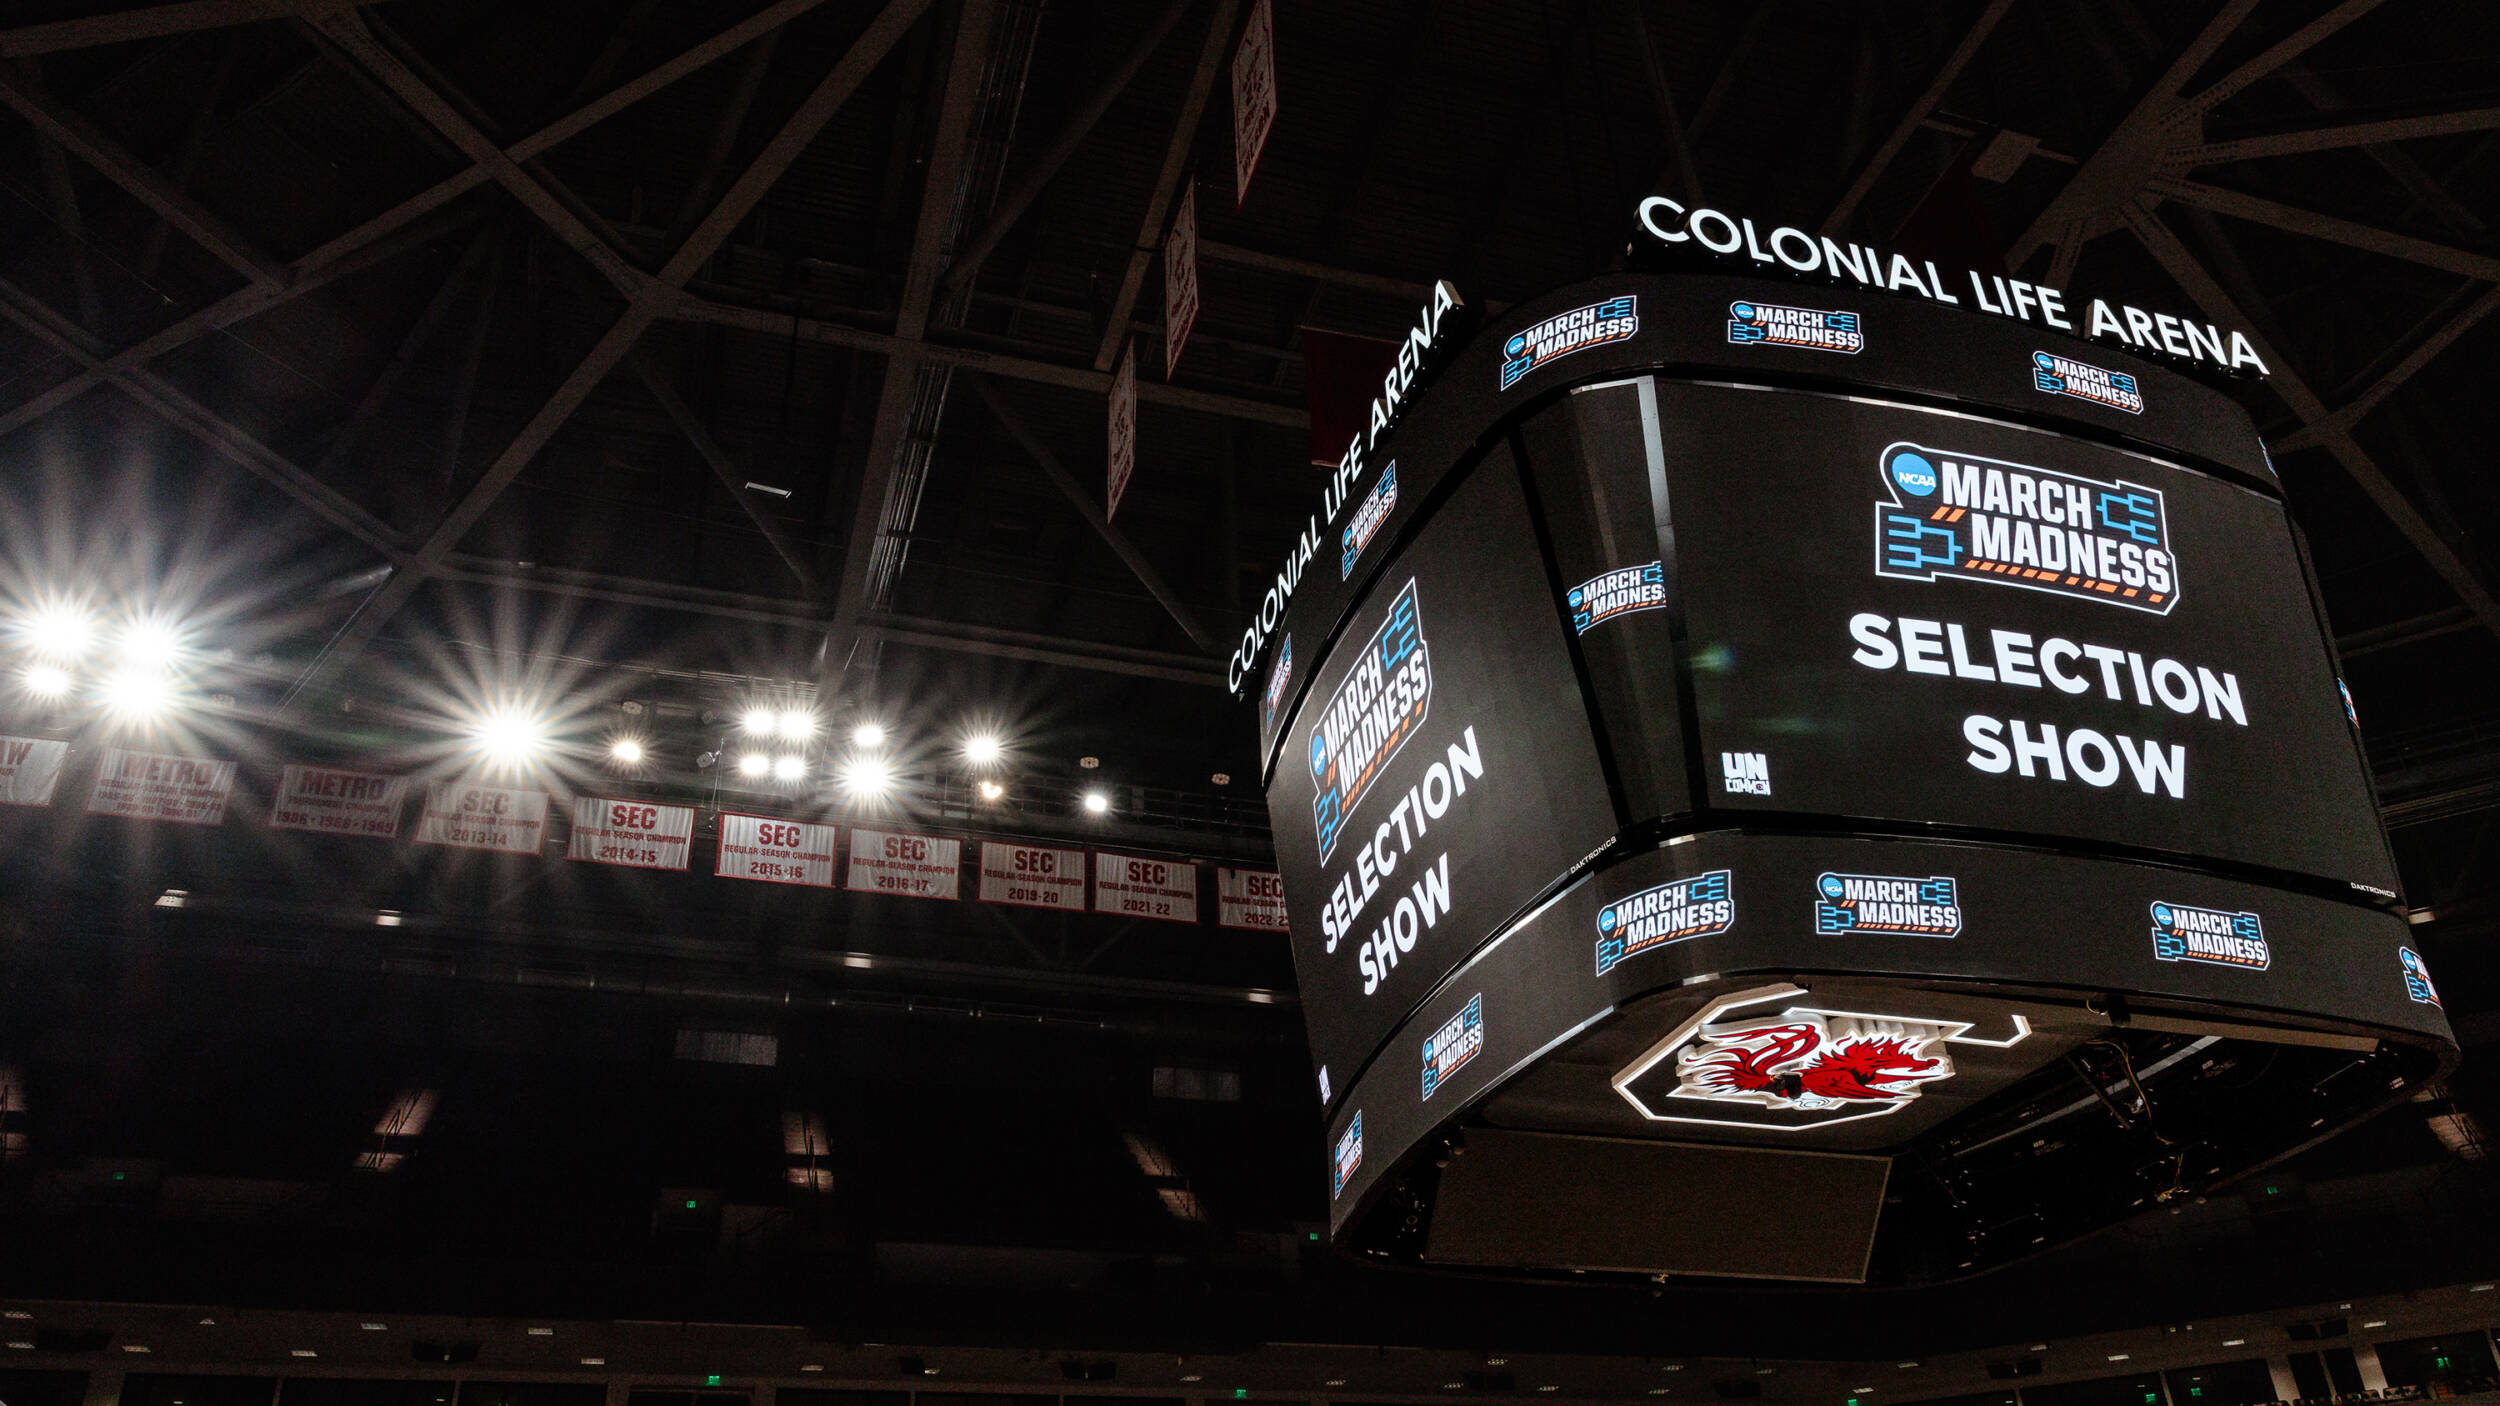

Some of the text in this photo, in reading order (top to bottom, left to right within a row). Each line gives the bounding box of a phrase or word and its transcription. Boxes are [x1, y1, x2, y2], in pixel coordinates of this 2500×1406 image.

[1639, 196, 2269, 375] COLONIAL LIFE ARENA
[1526, 308, 1595, 348] MARCH
[1756, 307, 1823, 328] MARCH
[1536, 317, 1634, 359] MADNESS
[1768, 323, 1860, 347] MADNESS
[2054, 359, 2110, 386] MARCH
[2066, 376, 2140, 408] MADNESS
[1229, 280, 1453, 694] COLONIAL LIFE ARENA
[1899, 472, 1936, 487] NCAA
[1942, 461, 2093, 528] MARCH
[1351, 487, 1379, 537] MARCH
[1356, 484, 1395, 549] MADNESS
[1972, 514, 2171, 594] MADNESS
[1583, 570, 1641, 603] MARCH
[1592, 584, 1665, 616] MADNES
[1849, 613, 2248, 726] SELECTION
[1324, 645, 1383, 761] MARCH
[1337, 649, 1427, 797] MADNESS
[123, 757, 212, 785] METRO
[1962, 714, 2185, 799] SHOW
[299, 770, 384, 800] METRO
[464, 790, 510, 814] SEC
[611, 805, 656, 829] SEC
[452, 829, 507, 845] 2013-14
[758, 823, 800, 848] SEC
[885, 837, 926, 861] SEC
[1322, 725, 1484, 953] SELECTION
[601, 845, 656, 862] 2014-15
[792, 852, 831, 862] CHAMPION
[1014, 850, 1053, 873] SEC
[1570, 836, 1617, 874] DAKTRONICS
[750, 862, 803, 878] 2015-16
[878, 876, 929, 891] 2016-17
[1128, 861, 1165, 885] SEC
[1008, 888, 1058, 903] 2019-20
[1248, 876, 1283, 898] SEC
[1844, 879, 1918, 903] MARCH
[2351, 882, 2396, 898] DAKTRONICS
[1123, 899, 1170, 916] 2021-22
[1616, 885, 1687, 928] MARCH
[1858, 901, 1957, 928] MADNESS
[1359, 852, 1451, 996] SHOW
[1627, 900, 1729, 946] MADNESS
[2172, 908, 2233, 936] MARCH
[2187, 931, 2266, 961] MADNESS
[1433, 1014, 1464, 1057] MARCH
[1438, 1023, 1480, 1075] MADNESS
